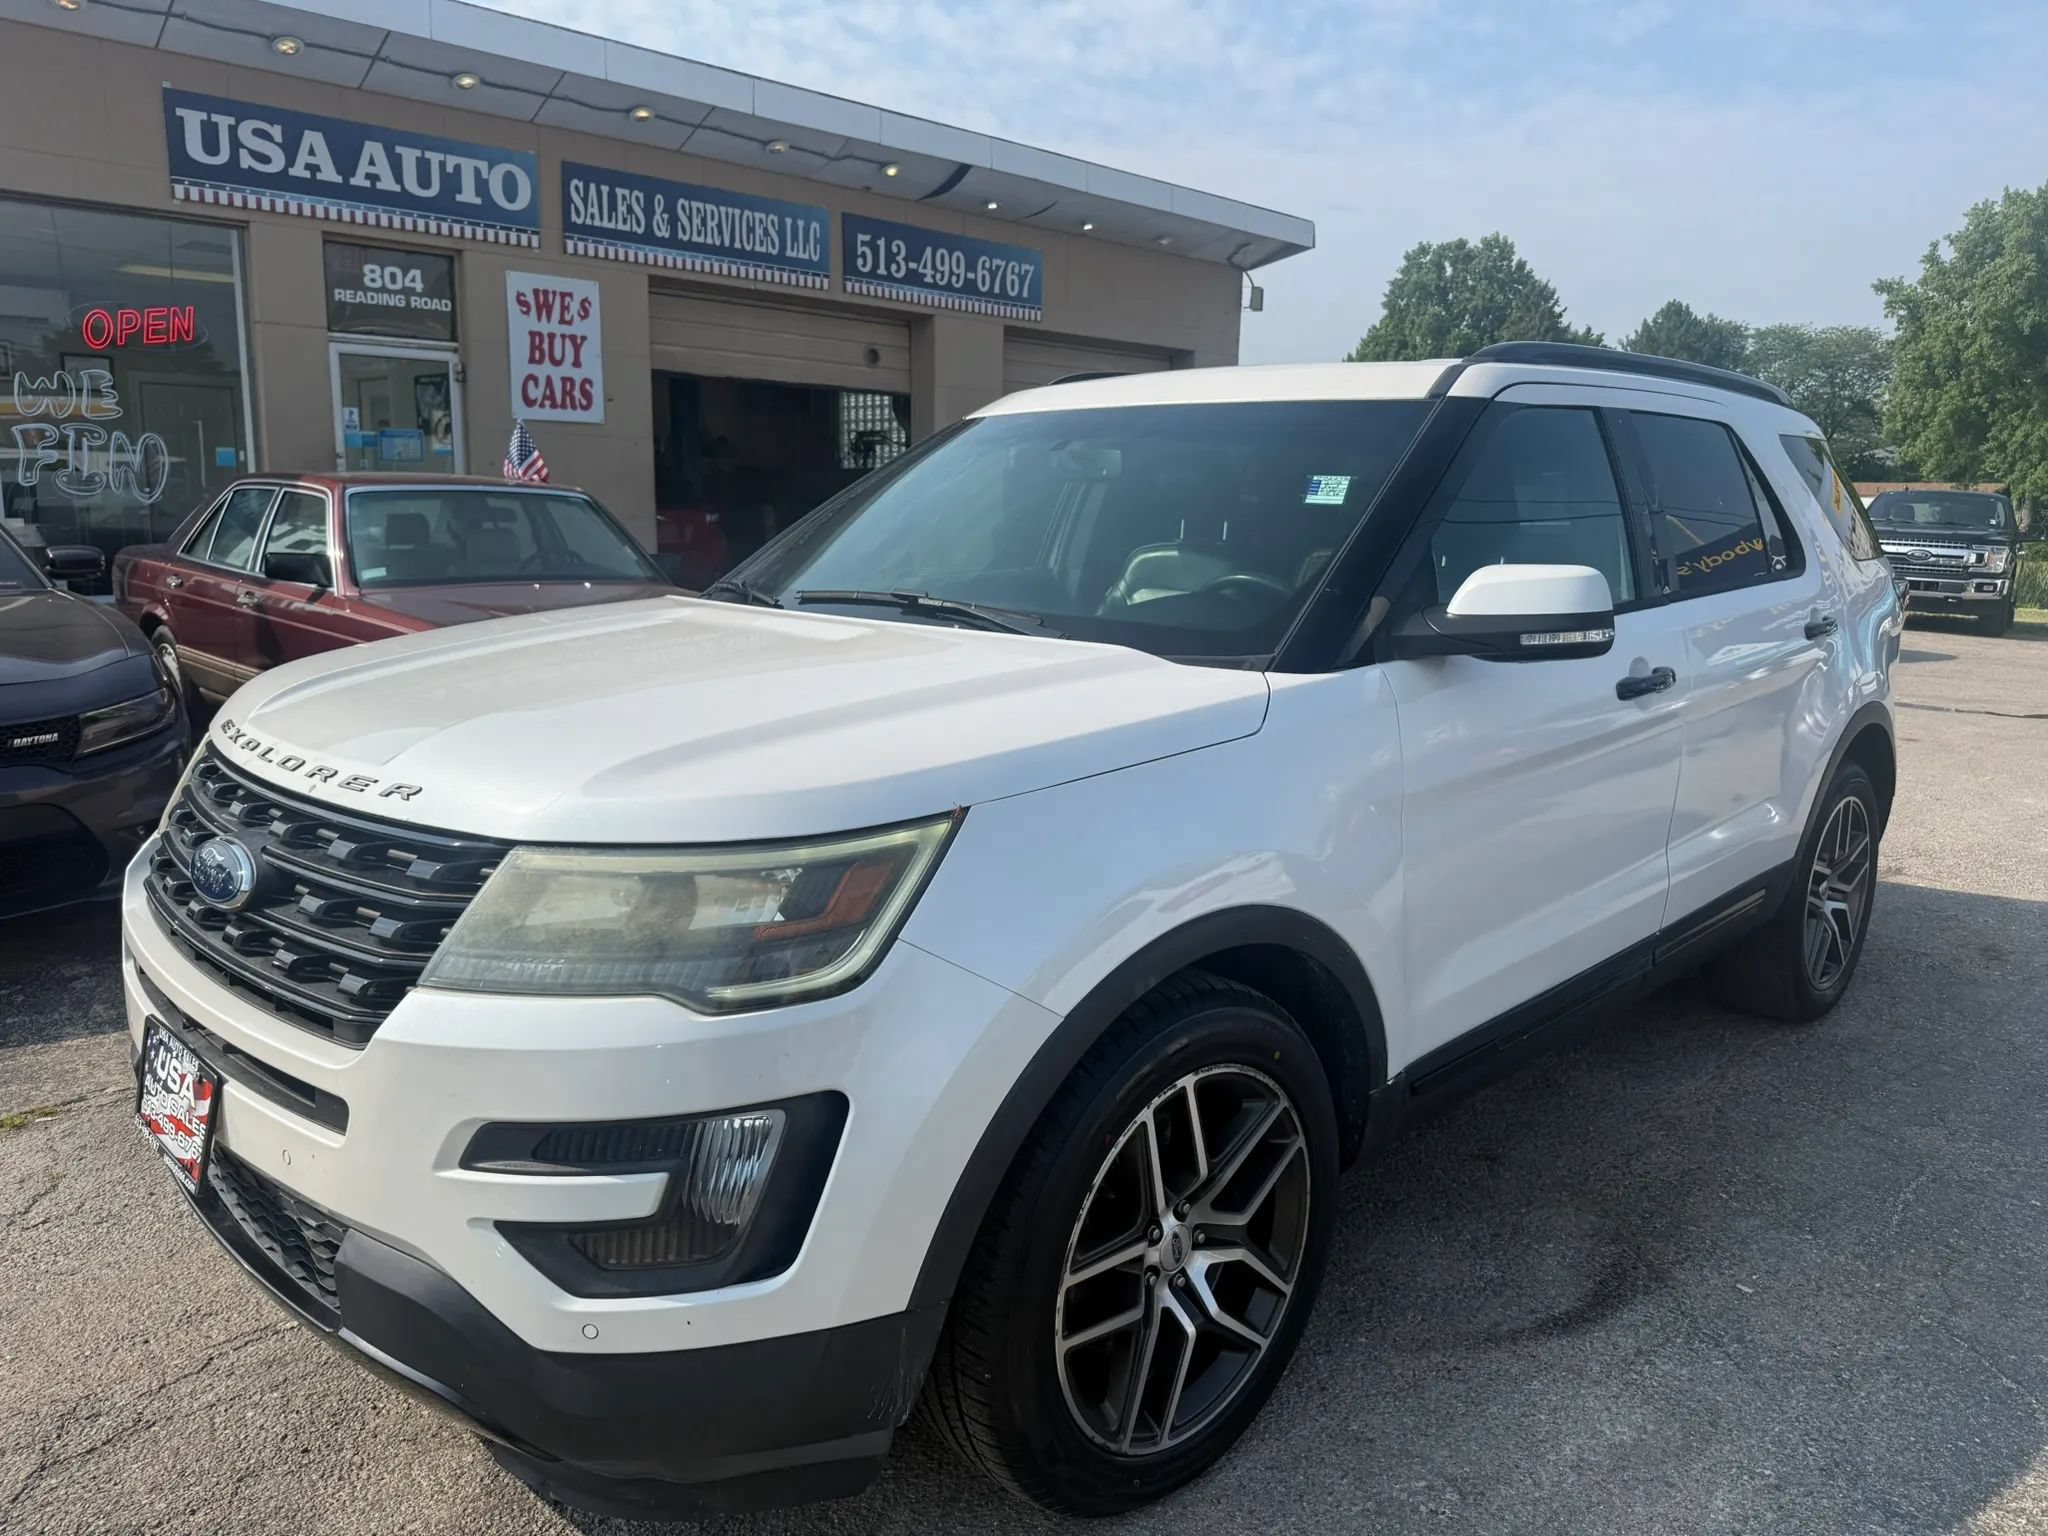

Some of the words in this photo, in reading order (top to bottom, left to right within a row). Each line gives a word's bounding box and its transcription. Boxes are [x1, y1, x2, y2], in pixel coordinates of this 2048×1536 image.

[175, 107, 342, 184] USA
[350, 140, 532, 211] AUTO
[569, 178, 646, 234] SALES
[652, 194, 671, 239] &
[677, 198, 779, 255] SERVICES
[785, 217, 820, 262] LLC
[363, 263, 424, 292] 804
[856, 233, 1035, 298] 513-499-6767
[334, 288, 407, 308] READING
[410, 296, 452, 312] ROAD
[82, 305, 195, 350] OPEN
[527, 330, 588, 368] BUY
[14, 369, 123, 420] WE
[521, 373, 594, 411] CARS
[13, 732, 59, 748] DAYTONA
[220, 718, 423, 802] EXPLORER
[156, 1045, 196, 1109] USA
[144, 1073, 168, 1110] AUTO
[170, 1097, 207, 1140] SALES
